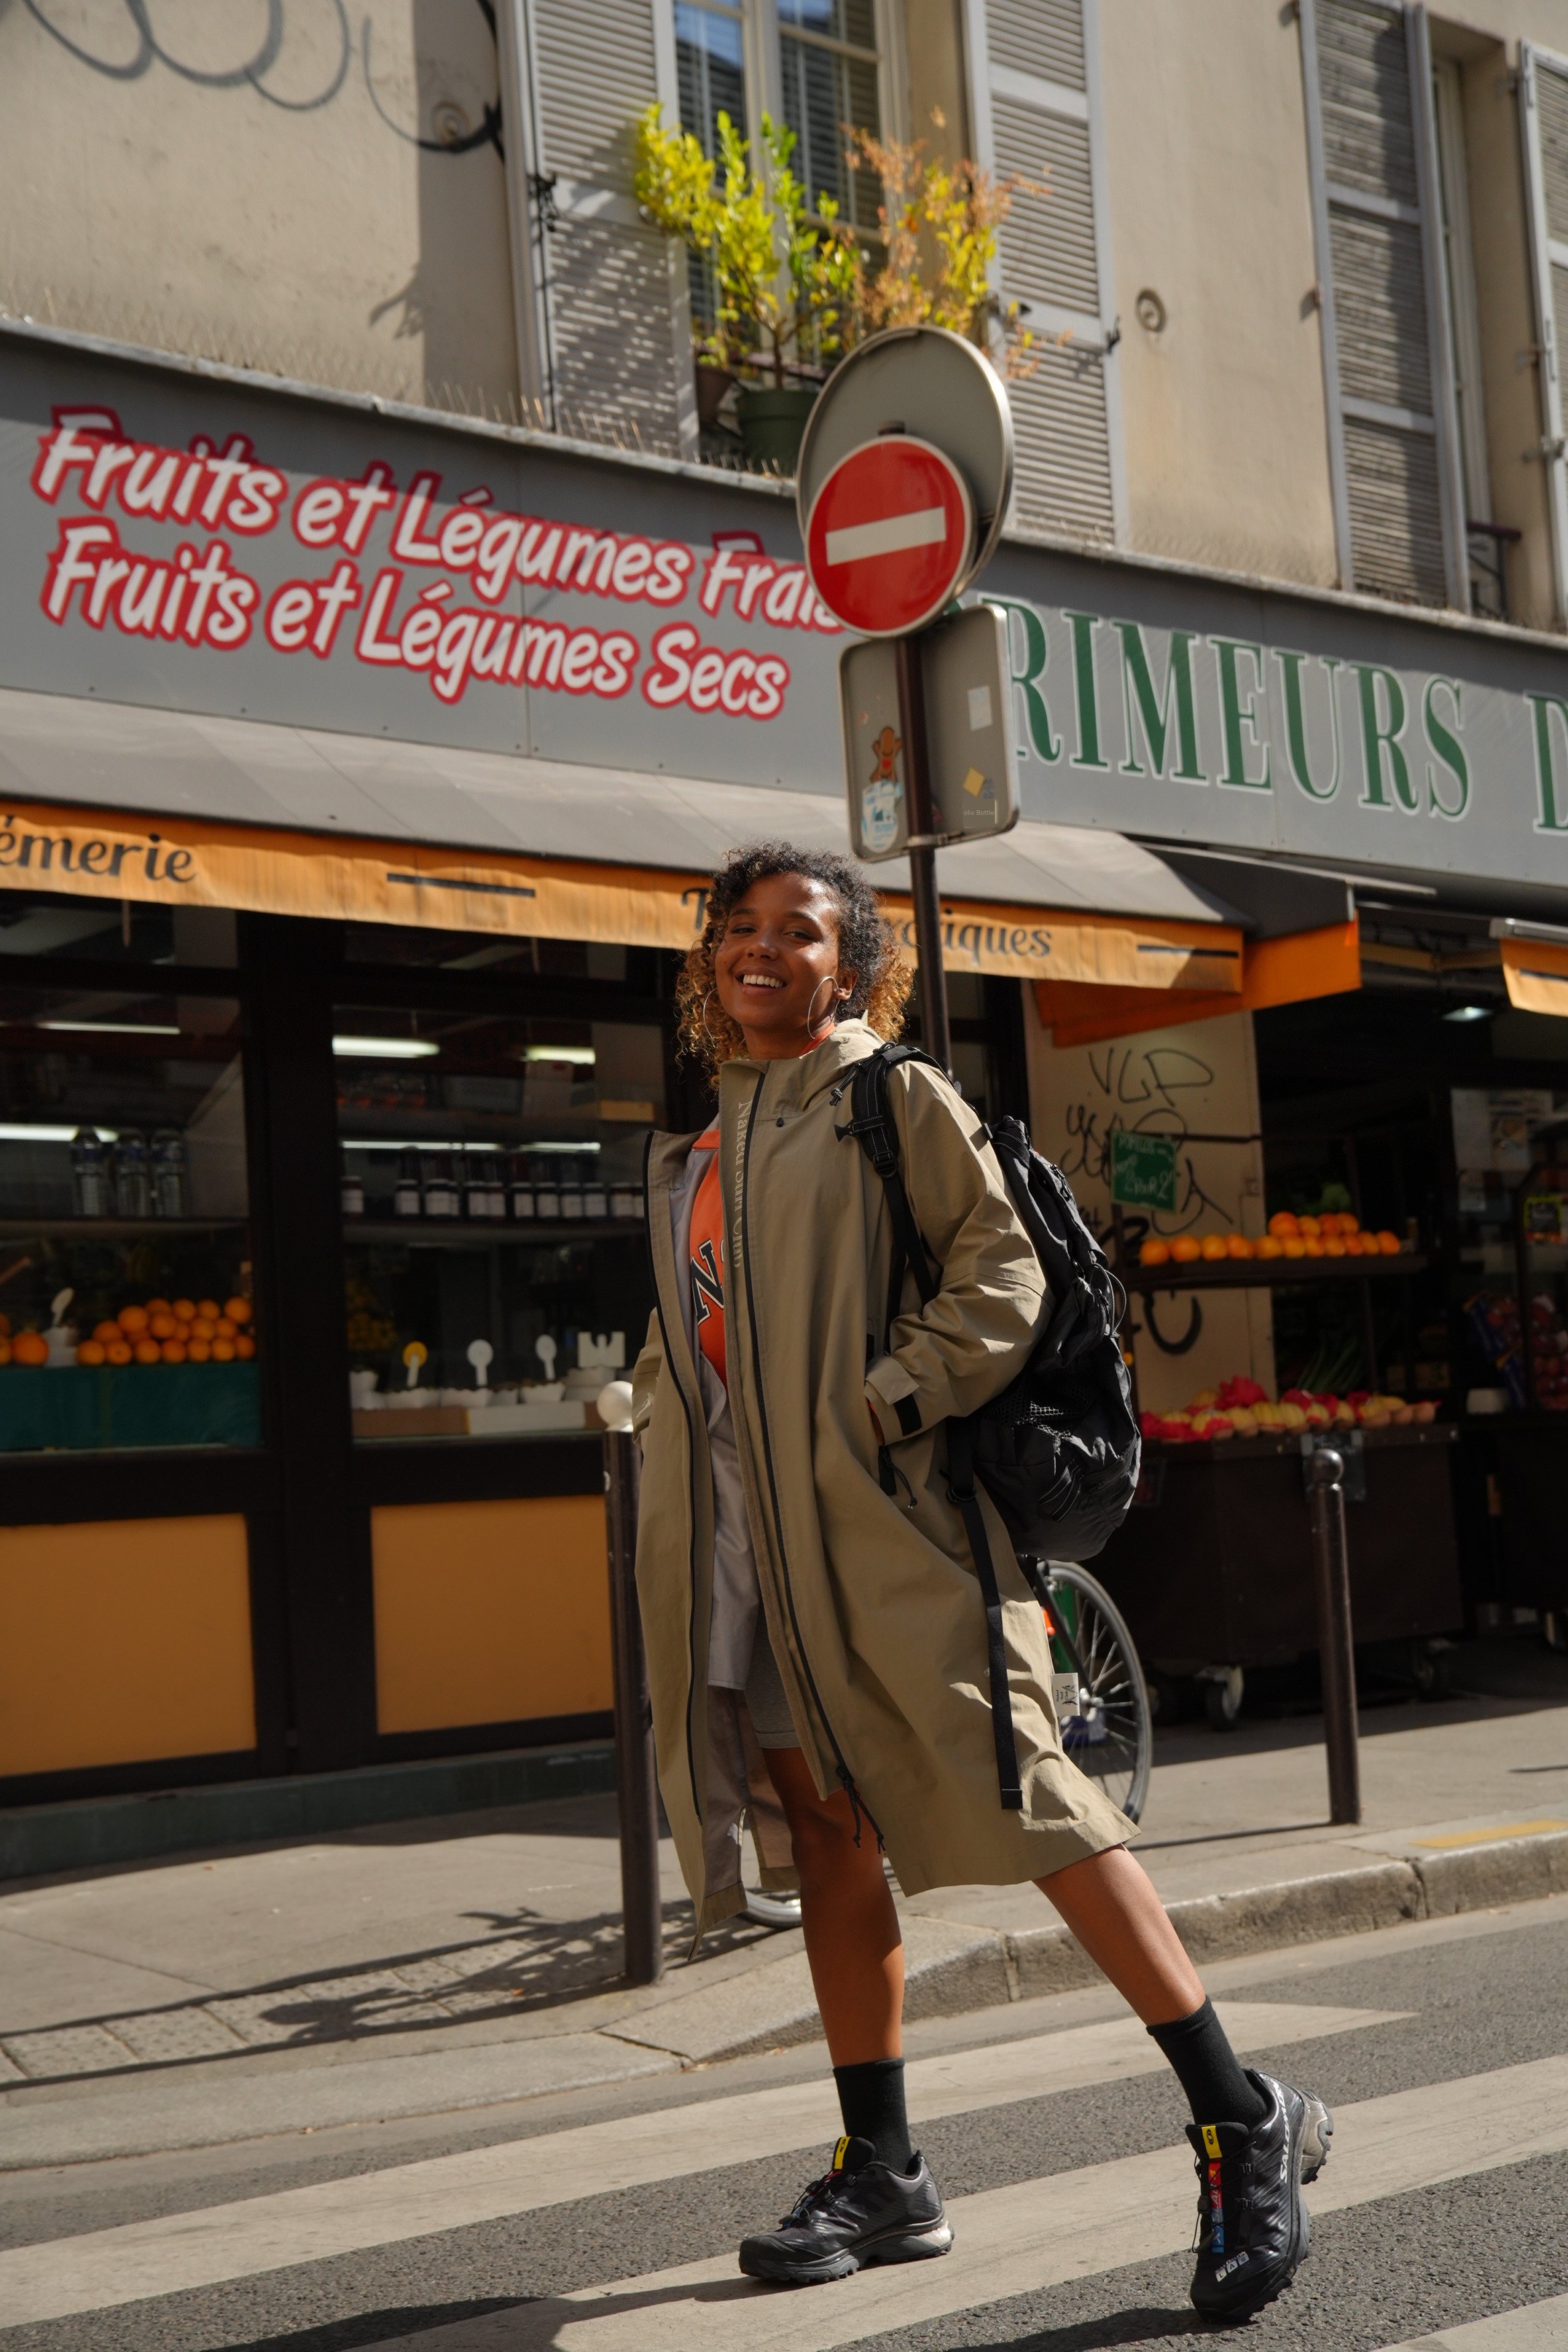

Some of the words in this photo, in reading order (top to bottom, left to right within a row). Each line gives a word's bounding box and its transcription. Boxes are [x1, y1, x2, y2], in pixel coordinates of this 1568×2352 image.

[31, 405, 287, 536] Fruits
[293, 460, 398, 555] et
[390, 471, 695, 605] Légumes
[41, 516, 260, 650] Fruits
[265, 559, 362, 660] et
[356, 567, 640, 705] Légumes
[642, 622, 790, 721] Secs
[943, 591, 1471, 822] RIMEURS
[1271, 2079, 1289, 2184] SALOMON
[1218, 2255, 1248, 2280] LAB
